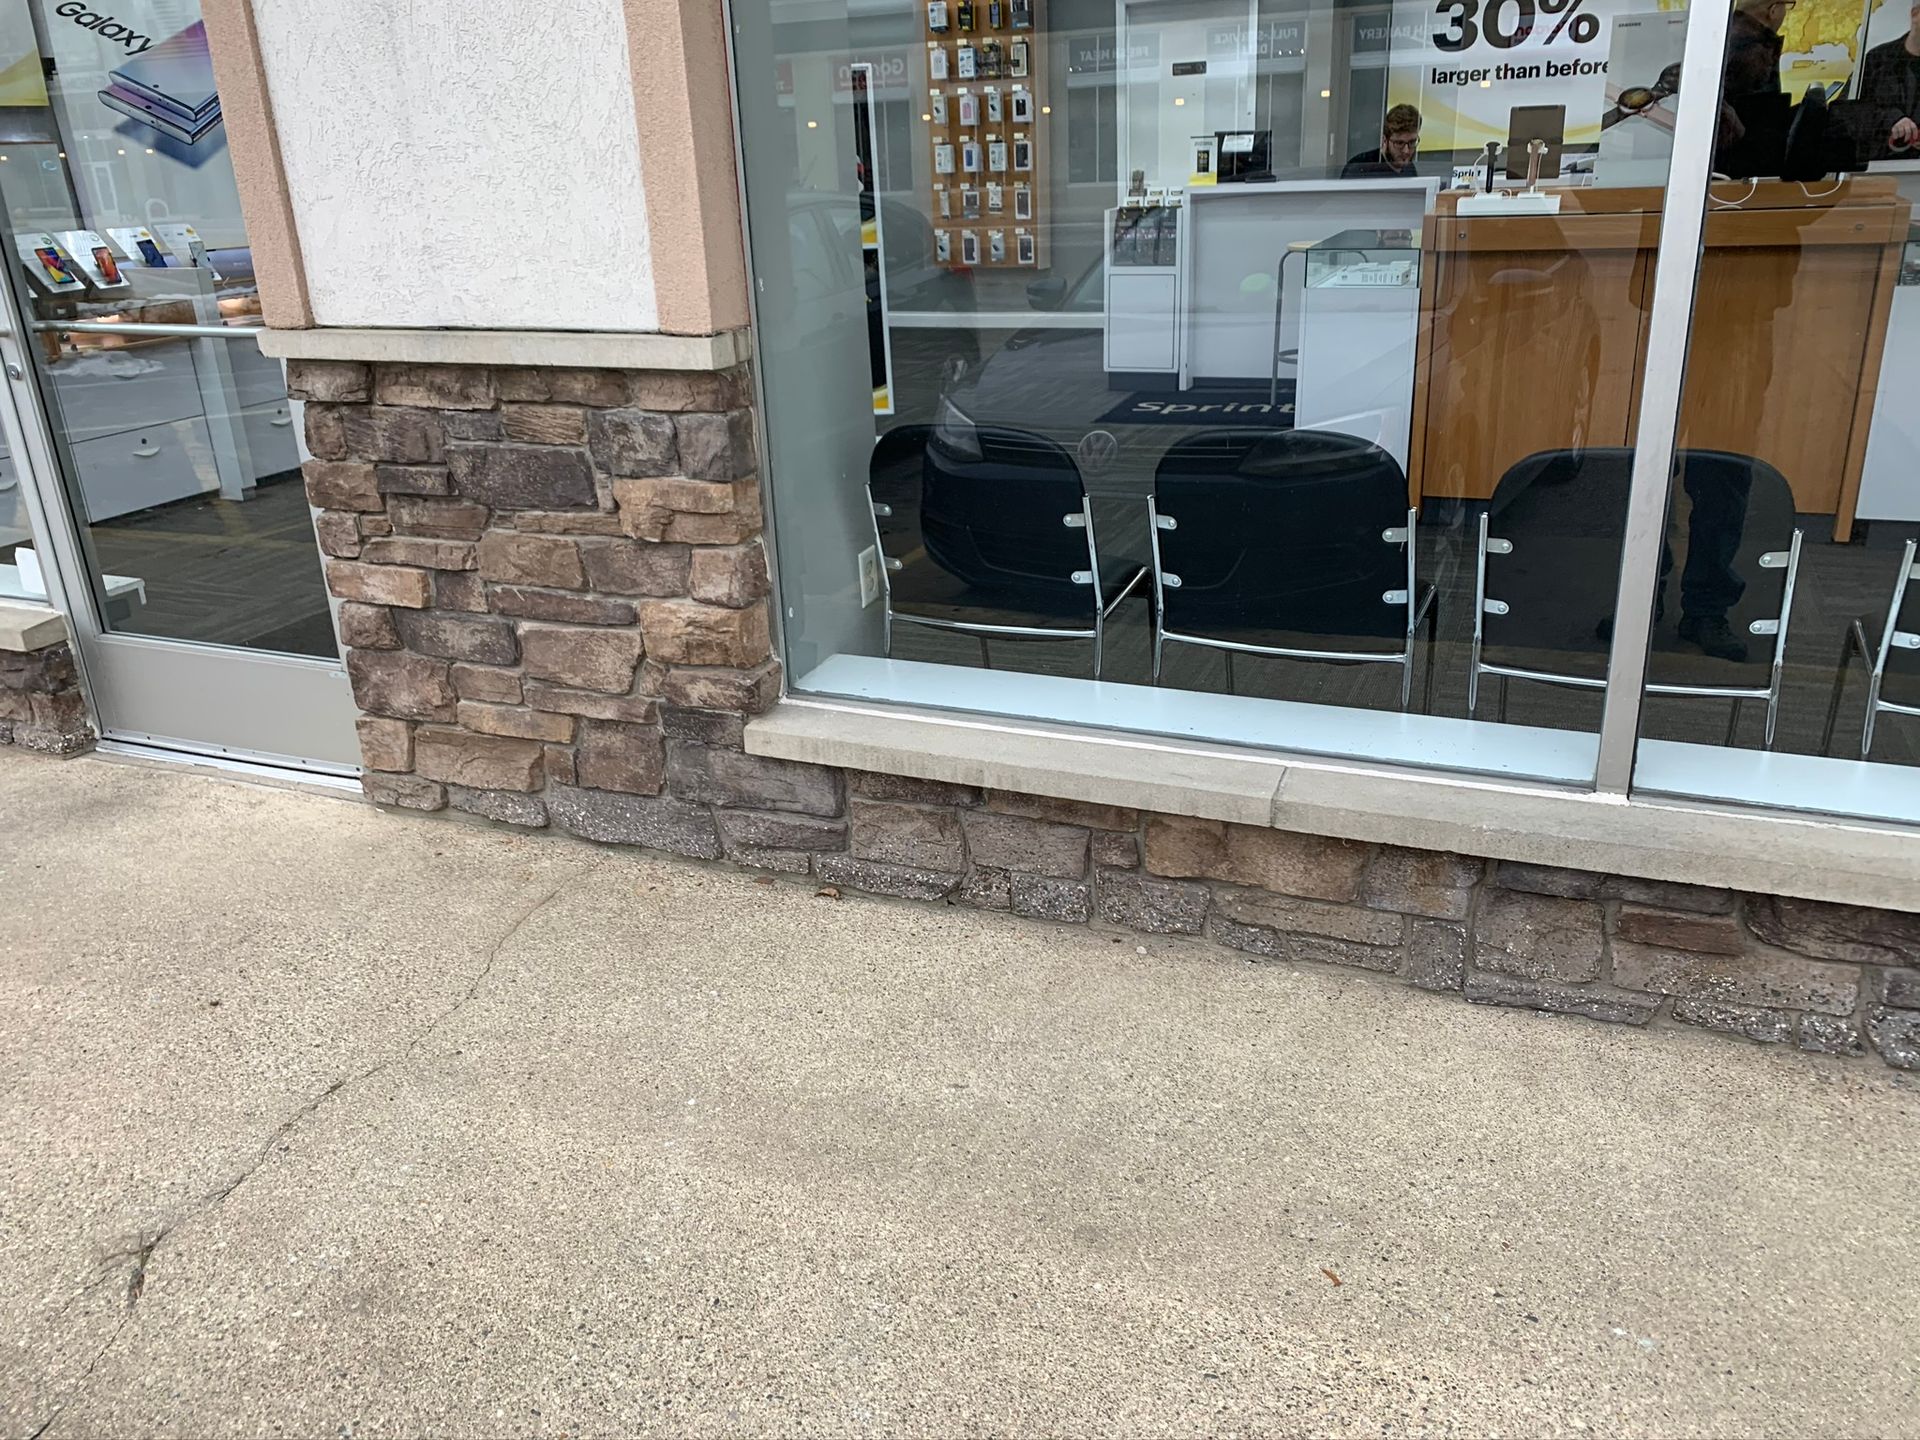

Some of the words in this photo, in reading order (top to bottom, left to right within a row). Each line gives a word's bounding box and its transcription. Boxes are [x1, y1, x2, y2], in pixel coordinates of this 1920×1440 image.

[56, 2, 154, 56] Galaxy
[1432, 0, 1600, 52] 30%
[1432, 67, 1490, 86] larger
[1496, 63, 1541, 80] than
[1132, 402, 1295, 415] Sprint
